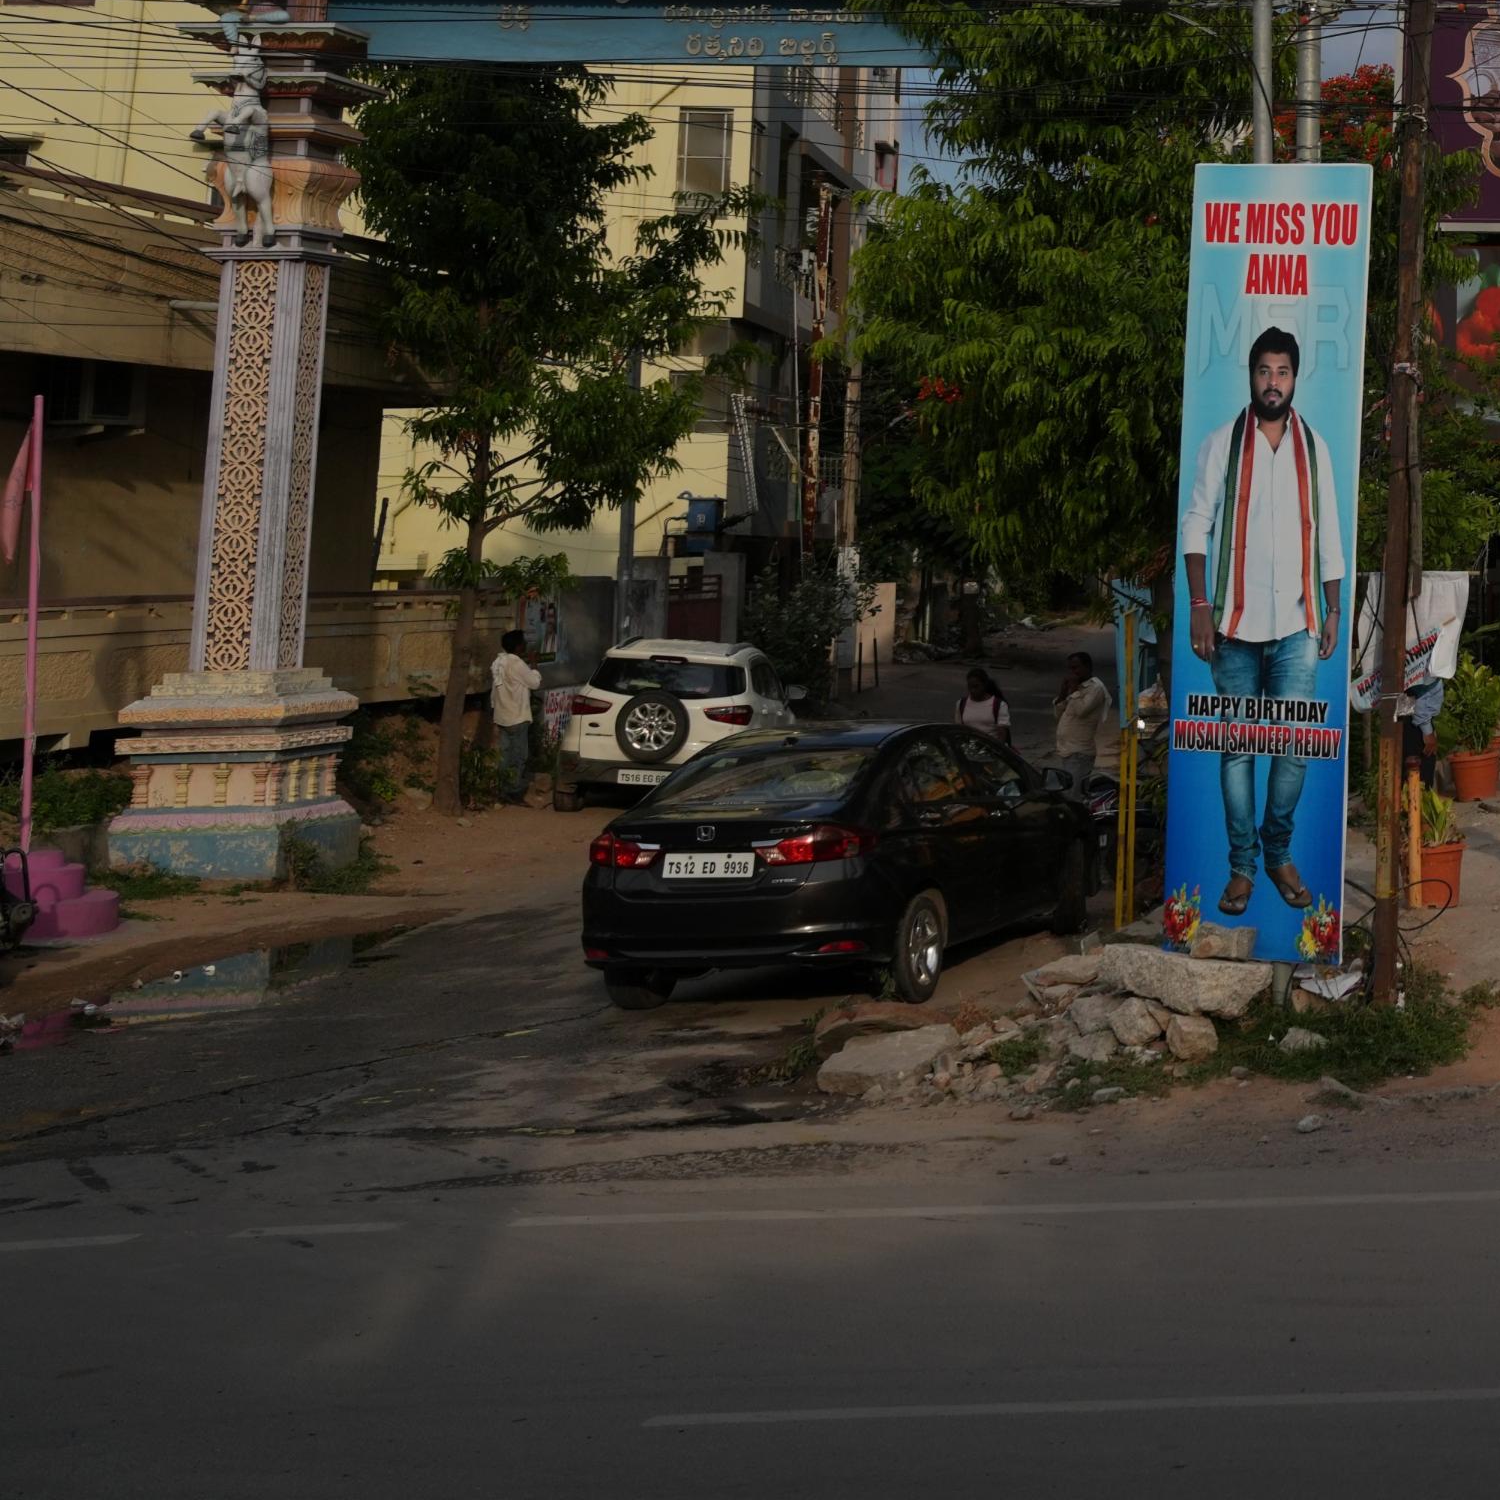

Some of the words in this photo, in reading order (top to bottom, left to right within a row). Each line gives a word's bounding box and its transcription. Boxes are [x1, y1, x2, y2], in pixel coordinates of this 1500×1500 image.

[1205, 202, 1241, 245] WE
[1245, 203, 1306, 245] MISS
[1311, 203, 1358, 247] YOU
[1245, 254, 1309, 296] ANNA
[1188, 695, 1242, 721] HAPPY
[1245, 697, 1328, 723] BIRTHDAY
[1174, 720, 1227, 752] MOSALI
[1229, 722, 1291, 756] SANDEEP
[1294, 727, 1342, 760] REDDY
[621, 773, 641, 782] TS16
[643, 774, 654, 783] EG
[702, 861, 716, 874] ED
[724, 861, 749, 874] 9936
